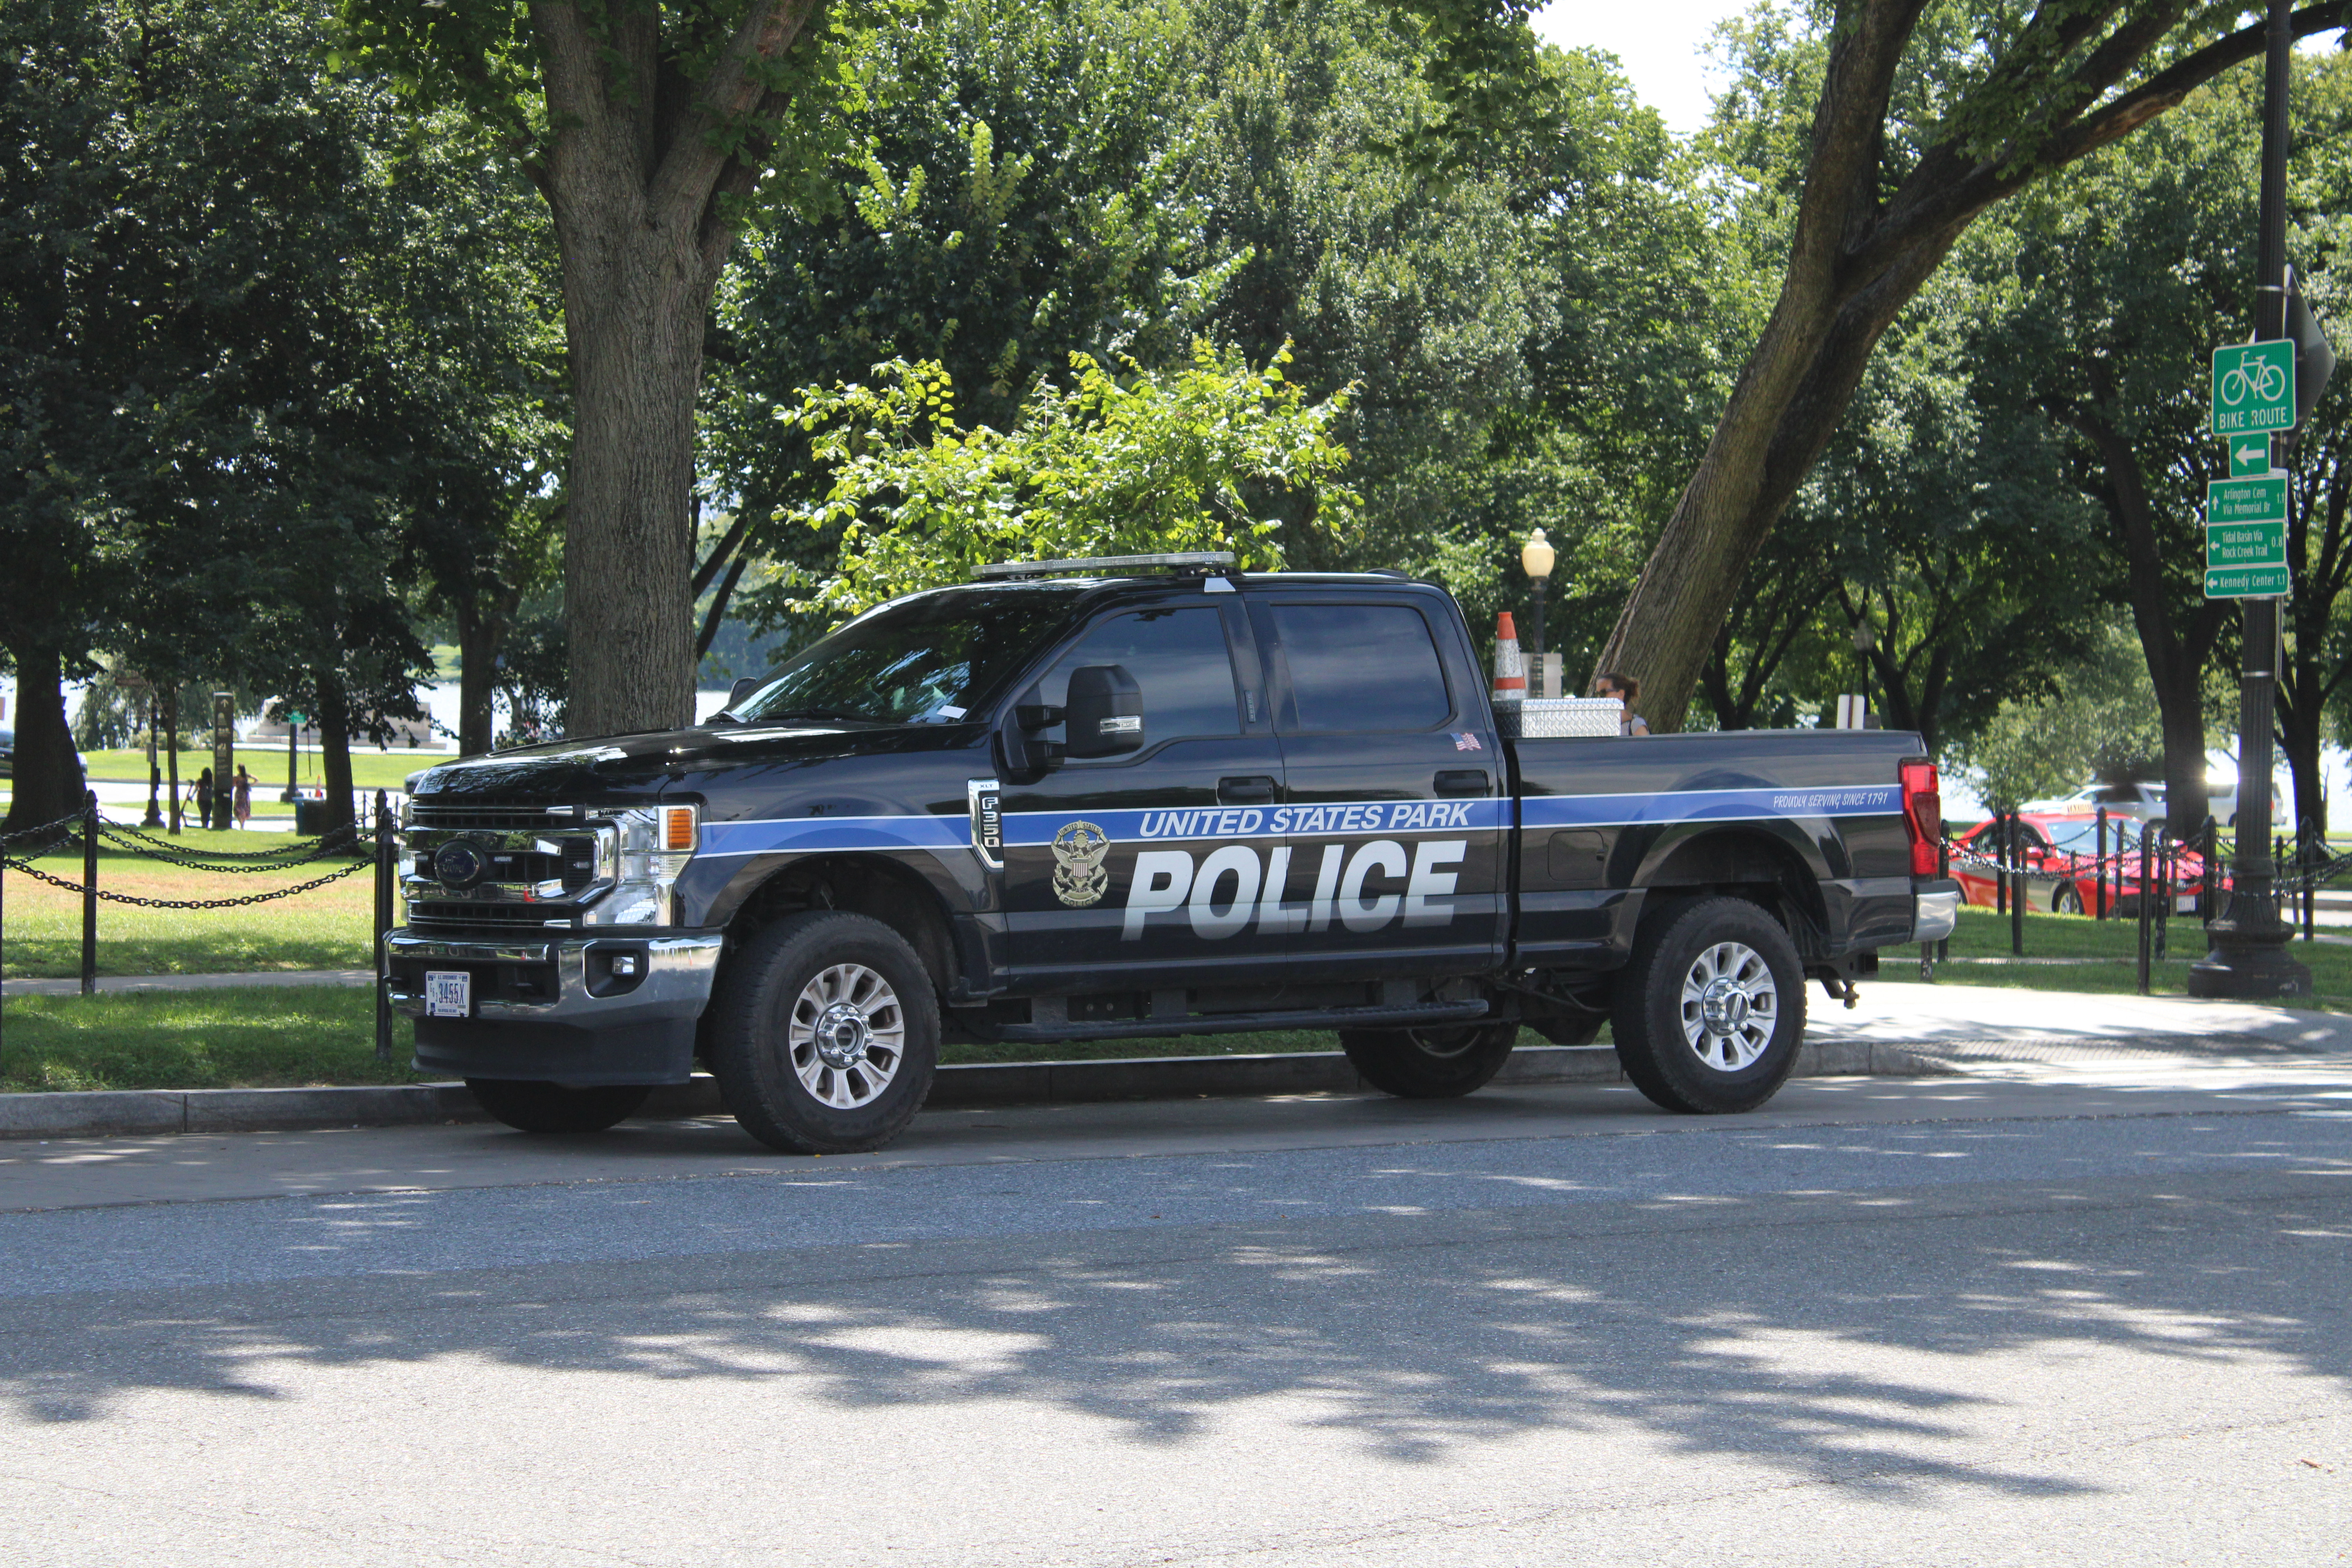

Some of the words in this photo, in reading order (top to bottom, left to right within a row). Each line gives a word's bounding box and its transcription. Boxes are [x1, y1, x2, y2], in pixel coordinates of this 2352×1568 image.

[2219, 411, 2245, 429] BIKE
[2251, 407, 2287, 426] ROUTE
[2223, 488, 2250, 502] Arlington
[2253, 487, 2266, 498] Cem
[2223, 503, 2232, 515] Via
[2235, 501, 2261, 514] Memorial
[2264, 501, 2270, 512] Br
[2223, 530, 2236, 543] Tidal
[2237, 529, 2252, 543] Basin
[2254, 529, 2263, 541] Via
[2272, 536, 2283, 547] 0.8
[2222, 545, 2236, 558] Rock
[2238, 544, 2254, 557] Creek
[2255, 543, 2268, 556] Trail
[2220, 575, 2249, 589] Kennedy
[2252, 574, 2274, 587] Center
[1774, 794, 1807, 808] PROUDLY
[1808, 793, 1841, 809] SERVING
[1842, 792, 1867, 806] SINCE
[1867, 791, 1888, 805] 1791
[982, 797, 1000, 848] F350
[1139, 807, 1263, 838] UNITED
[1269, 803, 1385, 833] STATES
[1388, 802, 1469, 829] PARK
[1061, 823, 1078, 834] UNITED
[1083, 822, 1100, 833] STATES
[1120, 840, 1466, 942] POLICE
[1063, 896, 1096, 906] POLICE
[439, 983, 464, 1004] 3455X
